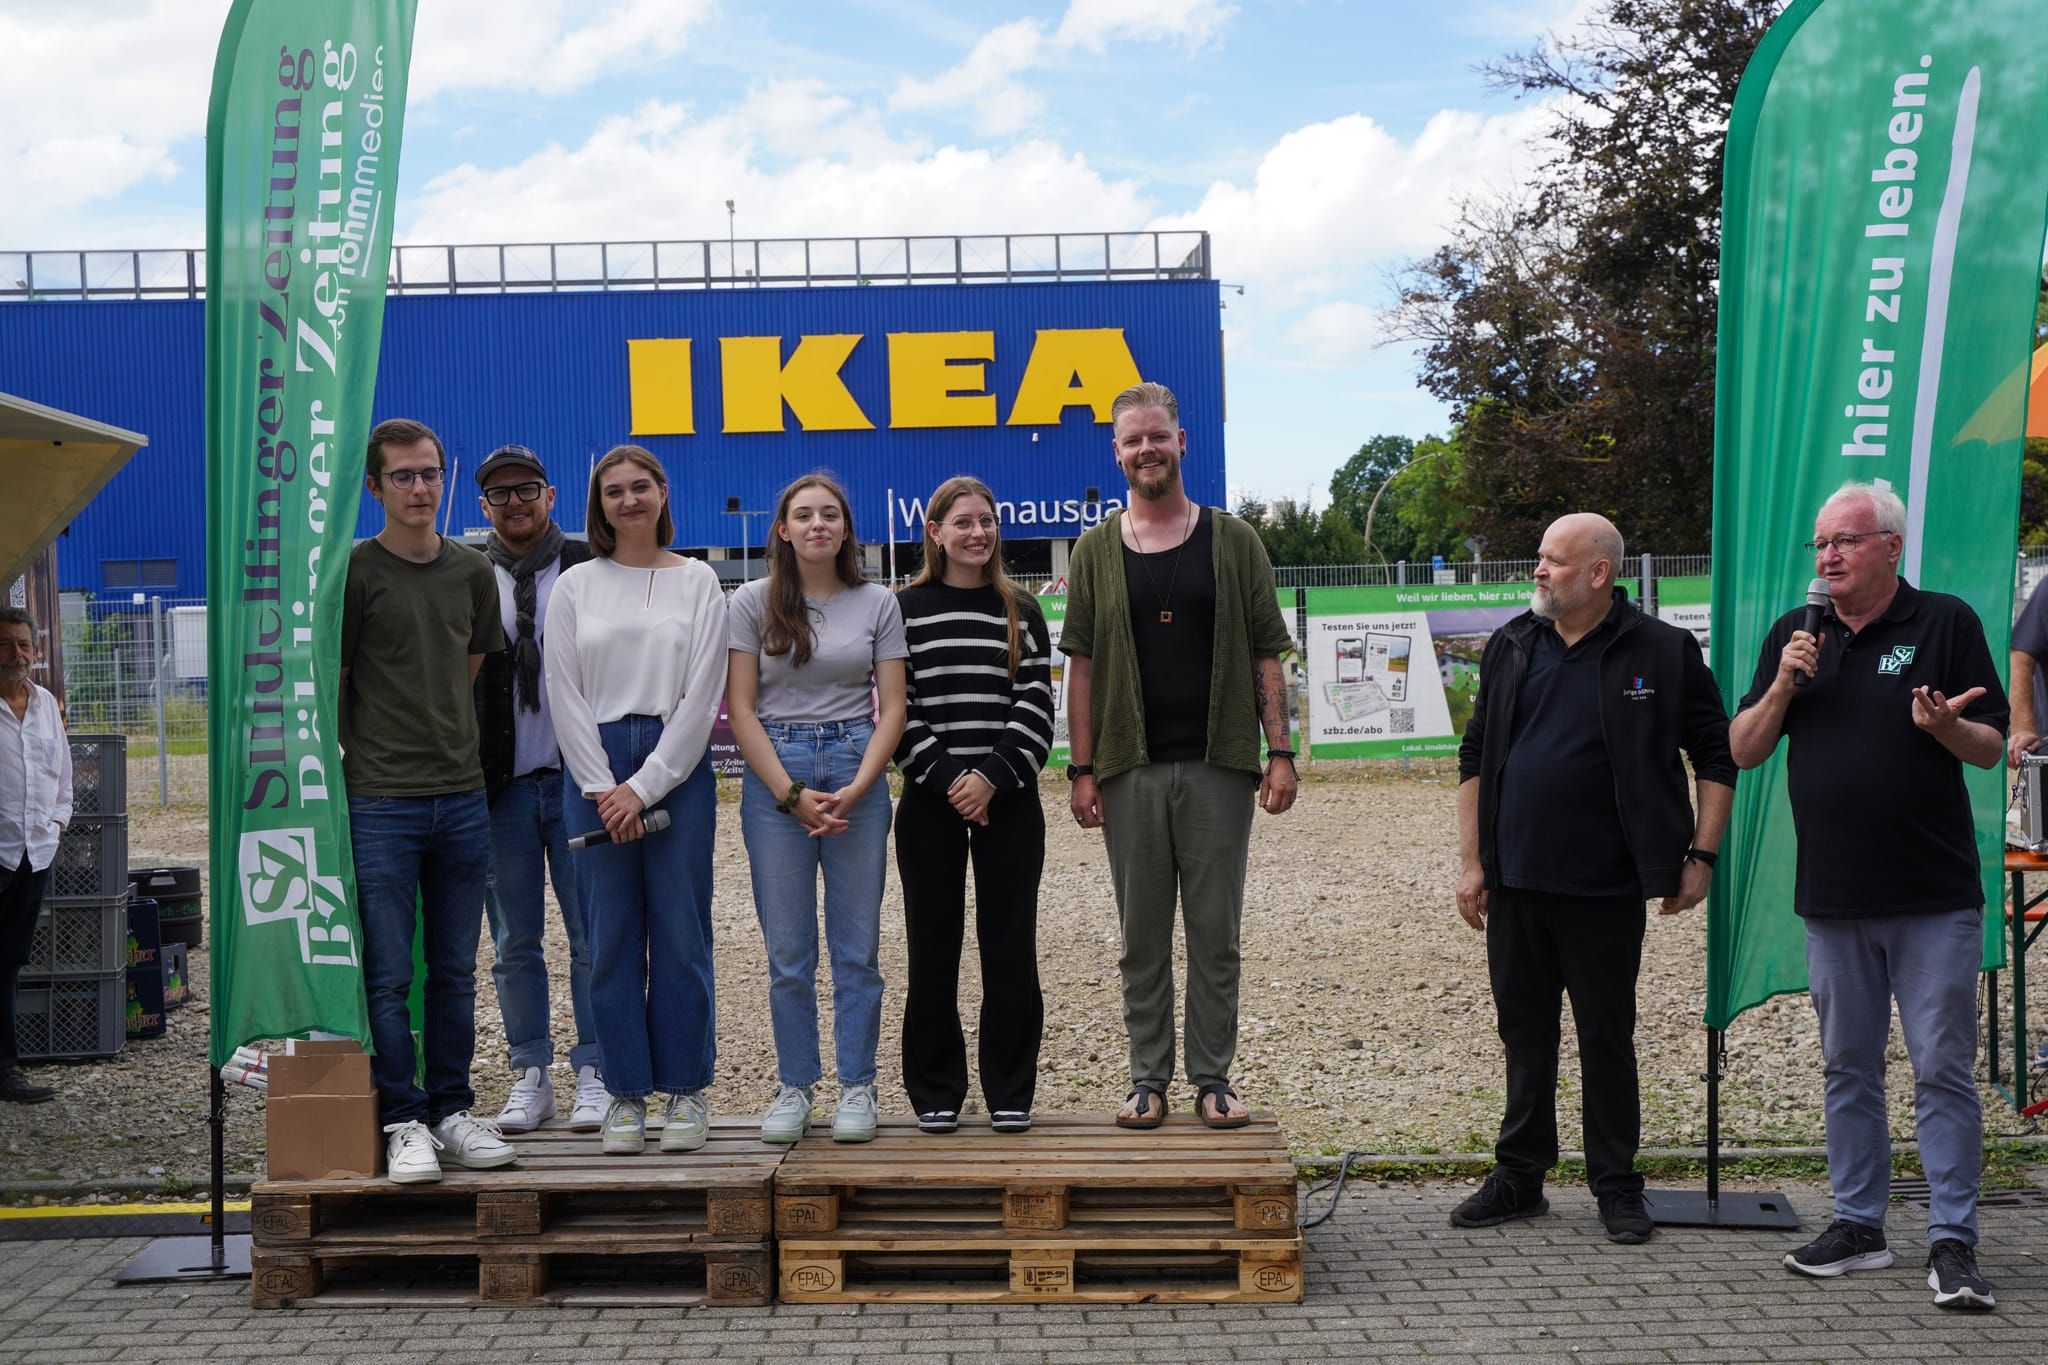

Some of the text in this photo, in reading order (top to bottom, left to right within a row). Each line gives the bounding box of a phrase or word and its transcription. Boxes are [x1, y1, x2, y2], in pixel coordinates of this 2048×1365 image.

[296, 39, 358, 378] Zeitung
[1841, 54, 1933, 457] hier zu leben.
[626, 328, 1143, 436] IKEA
[898, 489, 1131, 534] Wnausga
[1396, 590, 1536, 603] Weil wir lieben, hier zu leb
[1051, 602, 1067, 611] We
[1673, 613, 1705, 621] Testen
[1322, 623, 1354, 631] Testen
[1356, 622, 1370, 630] Sie
[1392, 622, 1416, 631] jetzt!
[1893, 648, 1912, 662] SZ
[1880, 657, 1901, 672] BZ
[1322, 725, 1383, 735] szbz.de/abo
[246, 834, 312, 912] SZ
[306, 876, 354, 966] BZ
[789, 1209, 820, 1225] EPAL
[266, 1274, 294, 1289] EPAL
[725, 1271, 752, 1287] EPAL
[798, 1271, 829, 1287] EPAL
[1260, 1271, 1291, 1287] EPAL
